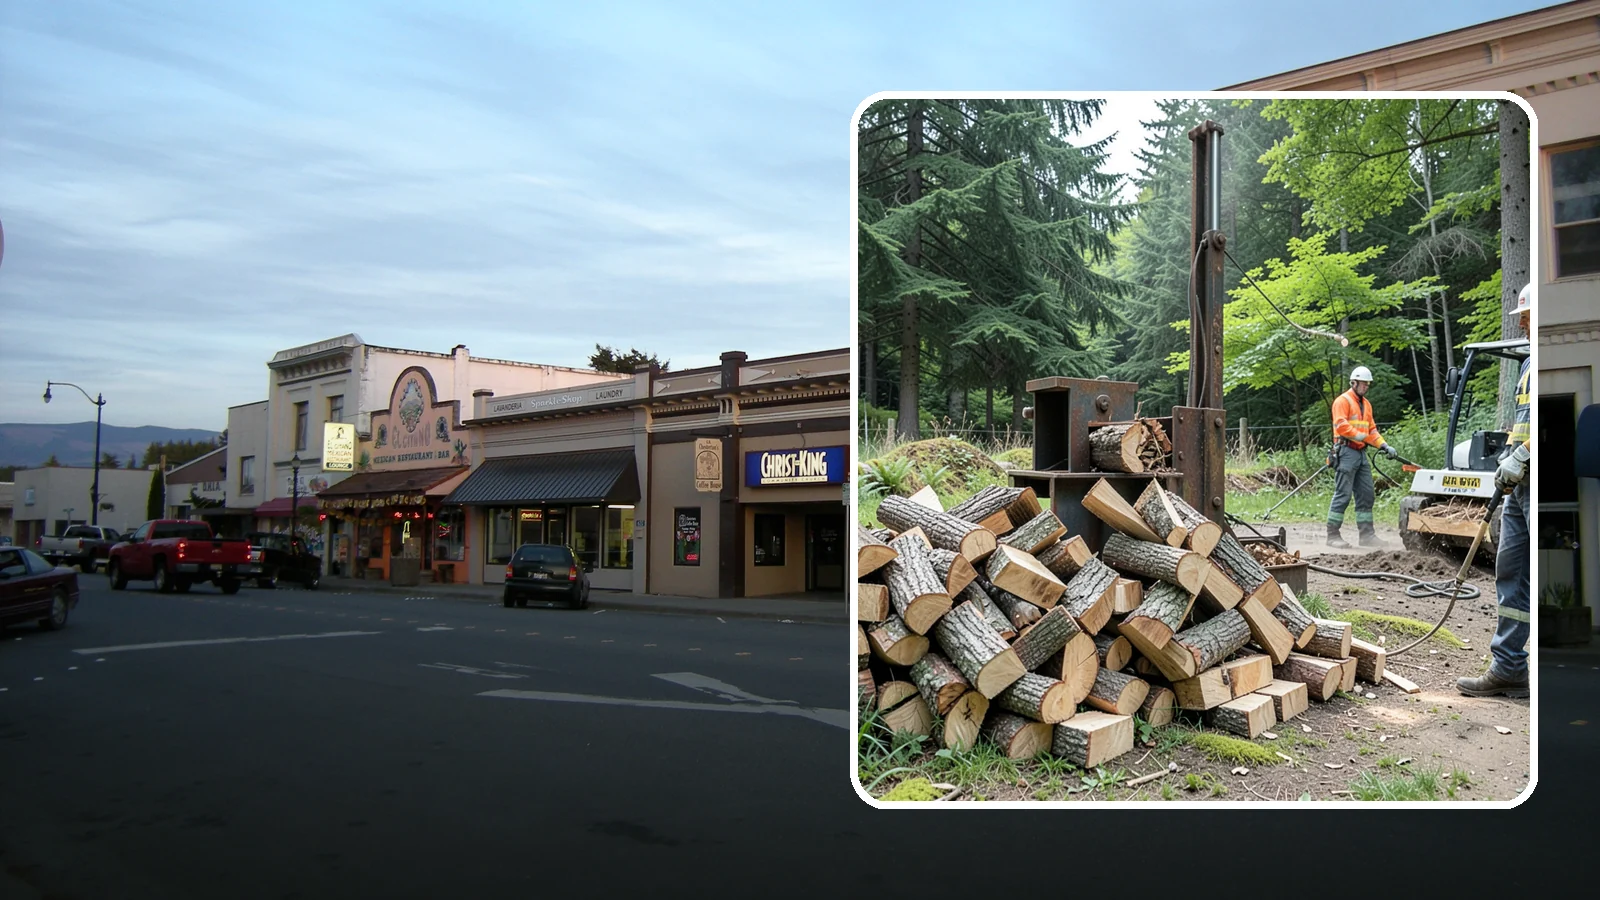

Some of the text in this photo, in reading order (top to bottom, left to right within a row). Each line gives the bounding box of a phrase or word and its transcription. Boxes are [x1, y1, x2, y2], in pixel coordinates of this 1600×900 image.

[562, 394, 582, 405] Shop
[595, 389, 623, 400] LAUNDRY
[493, 402, 522, 413] LAVANDERIA
[397, 450, 434, 462] RESTAURANT
[437, 450, 450, 459] BAR
